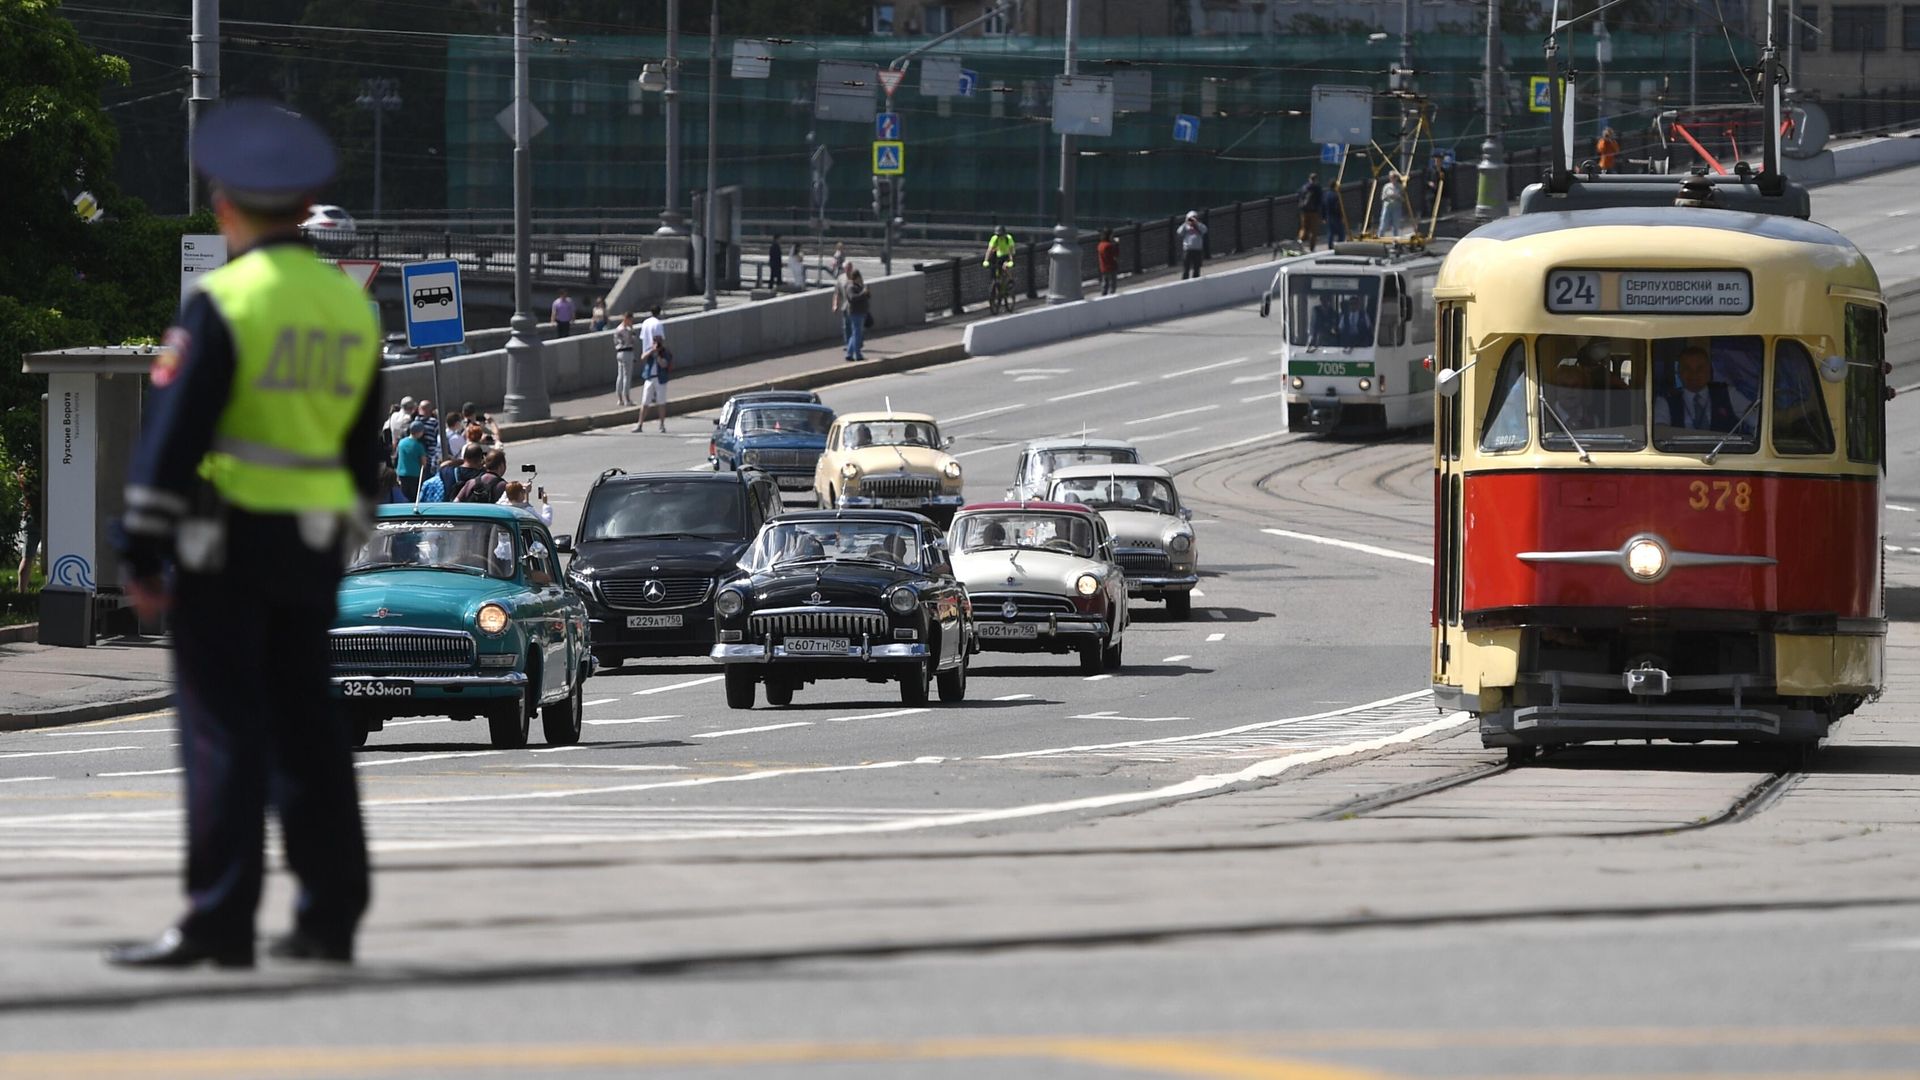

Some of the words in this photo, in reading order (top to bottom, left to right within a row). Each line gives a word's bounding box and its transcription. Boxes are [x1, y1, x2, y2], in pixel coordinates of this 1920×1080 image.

[1555, 275, 1595, 305] 24
[254, 326, 363, 397] ДПС
[1317, 362, 1346, 375] 7005
[63, 391, 72, 425] Ворота
[63, 427, 72, 465] Яузские
[1689, 480, 1752, 511] 378
[787, 640, 829, 651] С607ТН
[831, 639, 847, 648] 750
